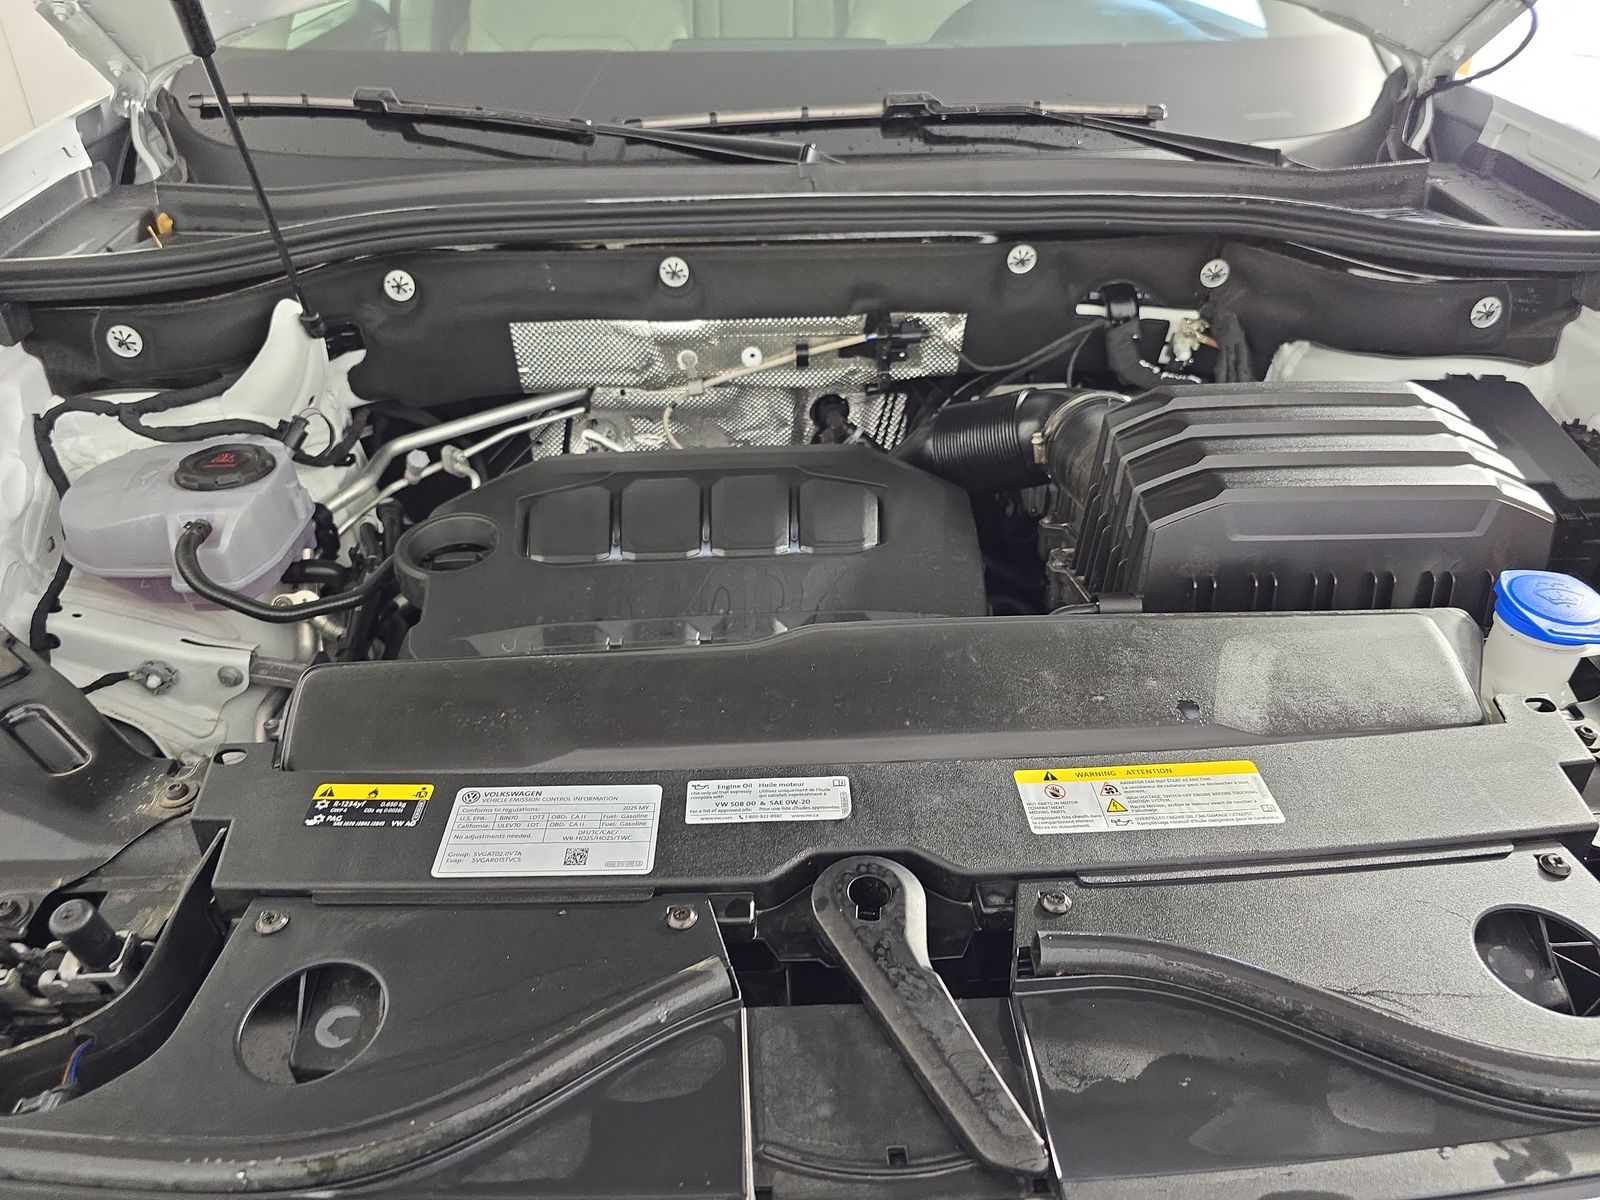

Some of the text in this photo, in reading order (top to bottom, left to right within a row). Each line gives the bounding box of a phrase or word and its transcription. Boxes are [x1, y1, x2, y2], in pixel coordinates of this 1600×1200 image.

[1074, 770, 1116, 778] WARNING
[502, 806, 540, 814] regulations:
[466, 833, 505, 842] adjustments
[448, 851, 471, 859] Group:
